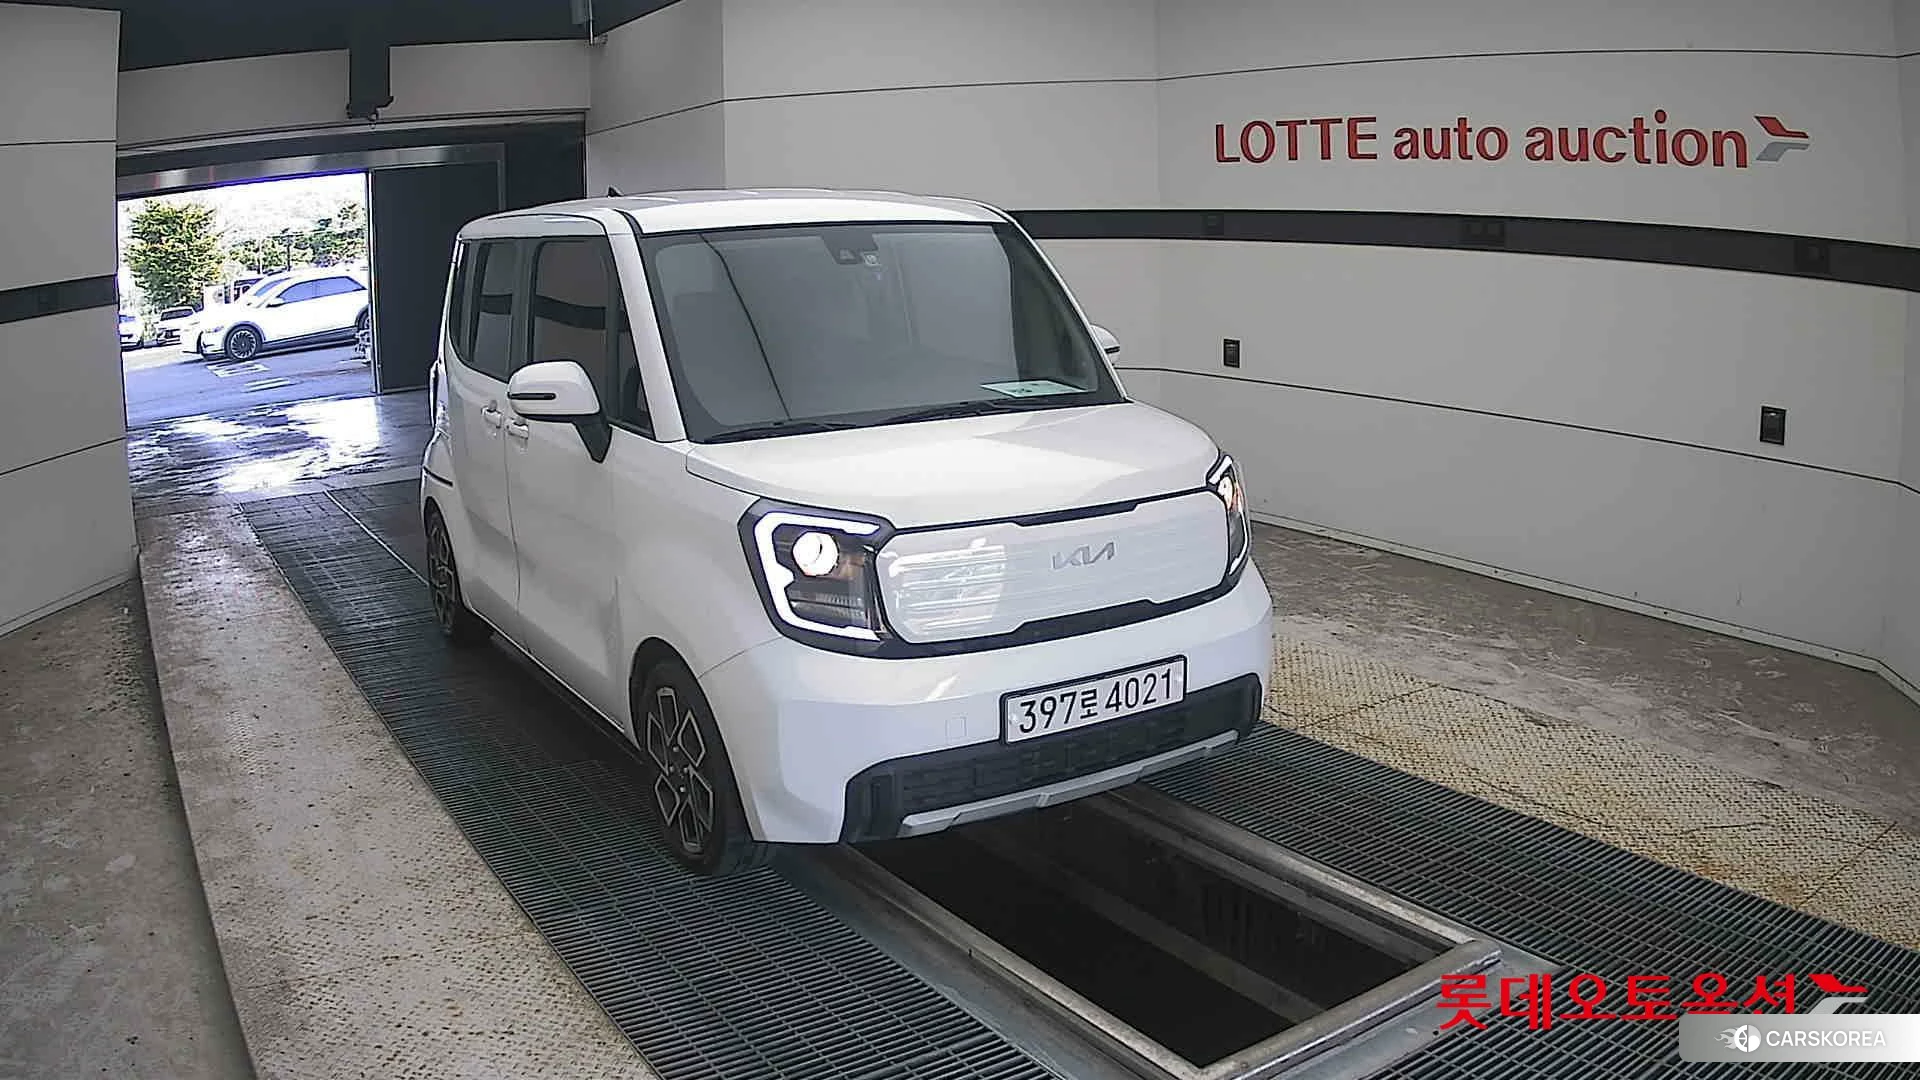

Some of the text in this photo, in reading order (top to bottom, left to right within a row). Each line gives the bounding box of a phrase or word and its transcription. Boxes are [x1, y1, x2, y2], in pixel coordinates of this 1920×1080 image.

[1214, 109, 1747, 168] LOTTE auto auction
